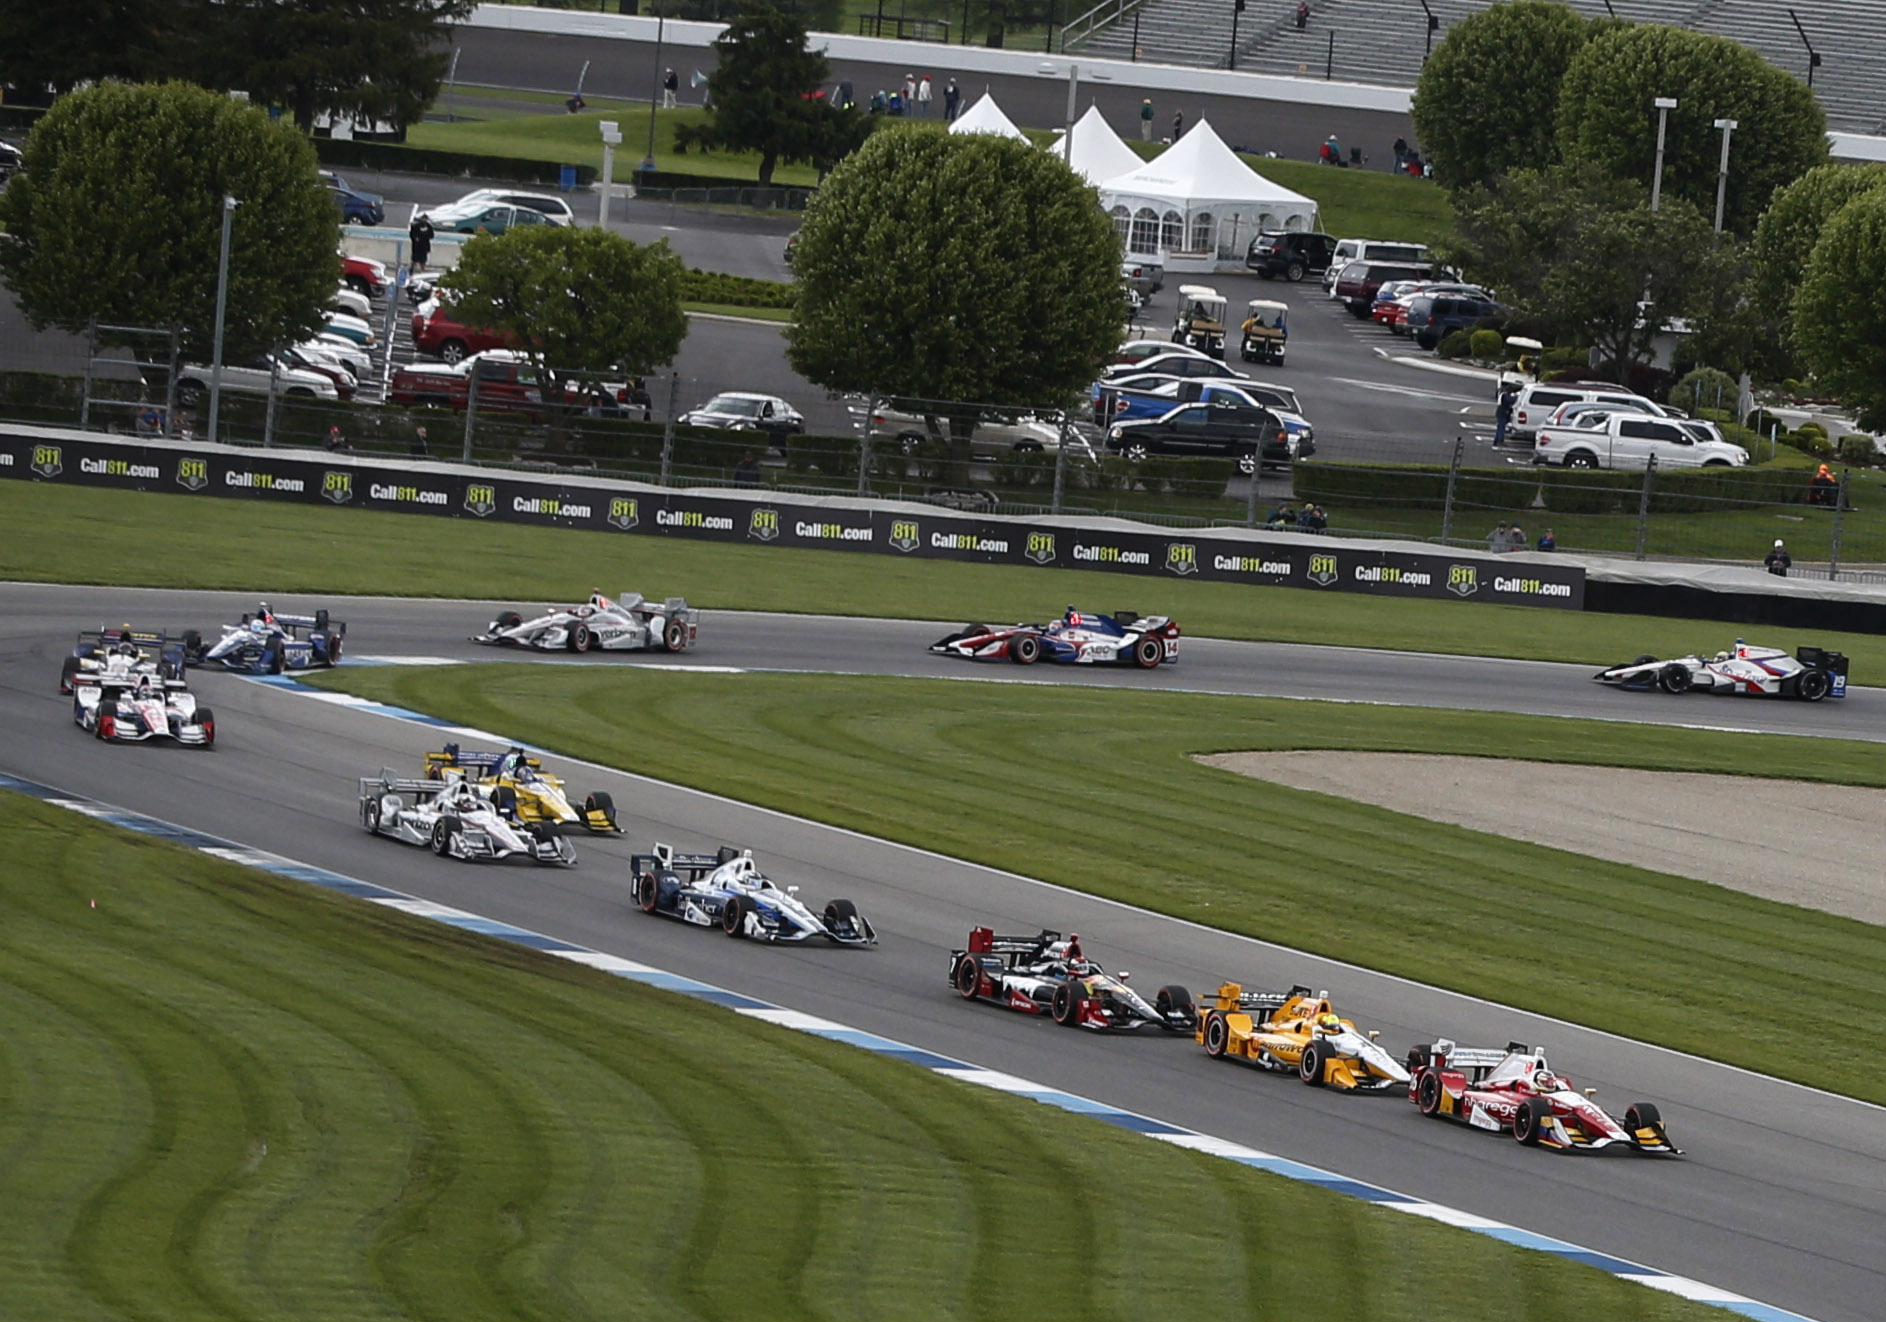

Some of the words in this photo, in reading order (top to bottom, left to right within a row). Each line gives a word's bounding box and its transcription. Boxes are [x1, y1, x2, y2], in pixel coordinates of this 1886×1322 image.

[35, 448, 59, 464] 811
[81, 458, 159, 478] Call811.com
[182, 461, 205, 477] 811
[226, 471, 304, 491] Call811.com
[325, 474, 350, 490] 811
[371, 484, 447, 504] Call811.com
[469, 487, 493, 503] 811
[513, 497, 591, 517] Call811.com
[612, 499, 636, 516] 811
[656, 510, 733, 529] Call811.com
[752, 511, 776, 527] 811
[795, 522, 872, 541] Call811.com
[893, 522, 917, 538] 811
[931, 533, 1008, 552] Call811.com
[1029, 535, 1052, 550] 811
[1073, 545, 1150, 564] Call811.com
[1170, 545, 1193, 561] 811
[1214, 555, 1291, 574] Call811.com
[1311, 556, 1335, 572] 811
[1355, 566, 1431, 585] Call811.com
[1450, 566, 1474, 583] 811
[1494, 577, 1571, 596] Call811.com
[1166, 641, 1178, 654] 14
